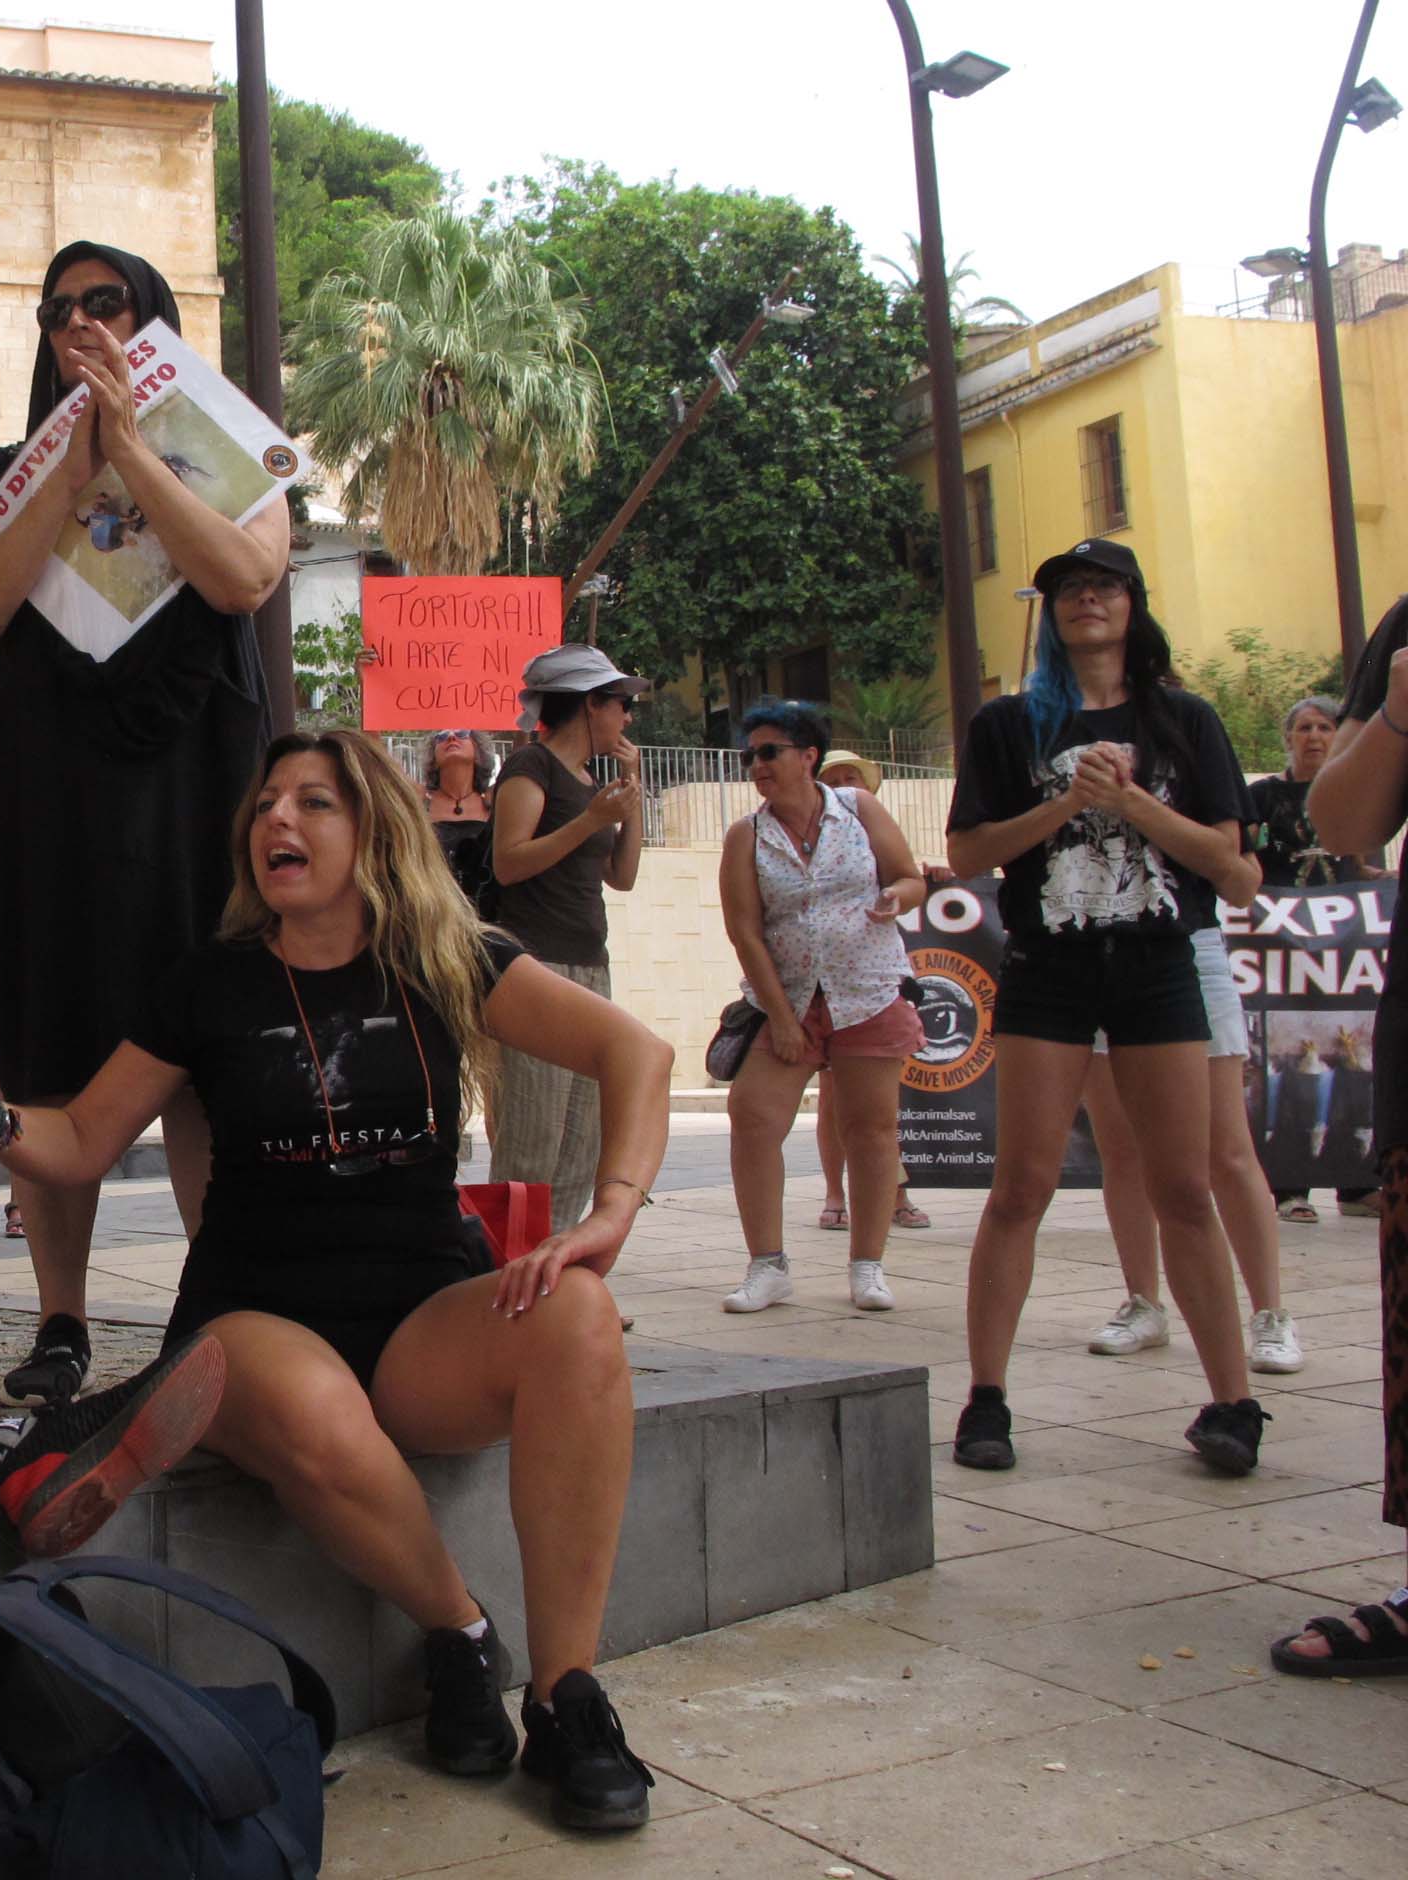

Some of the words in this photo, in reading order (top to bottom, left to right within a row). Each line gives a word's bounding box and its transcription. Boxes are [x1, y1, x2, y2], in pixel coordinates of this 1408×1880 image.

[127, 339, 157, 370] ES
[379, 585, 543, 637] TORTURA!!
[371, 636, 393, 669] NI
[407, 640, 465, 670] ARTE
[482, 641, 511, 675] NI
[395, 680, 518, 714] CULTURA
[925, 953, 977, 983] ANIMAL
[1228, 949, 1389, 995] SINA
[904, 1066, 940, 1088] SAVE
[262, 1138, 293, 1152] TU
[312, 1128, 403, 1148] FIESTA
[936, 1152, 974, 1164] Animal
